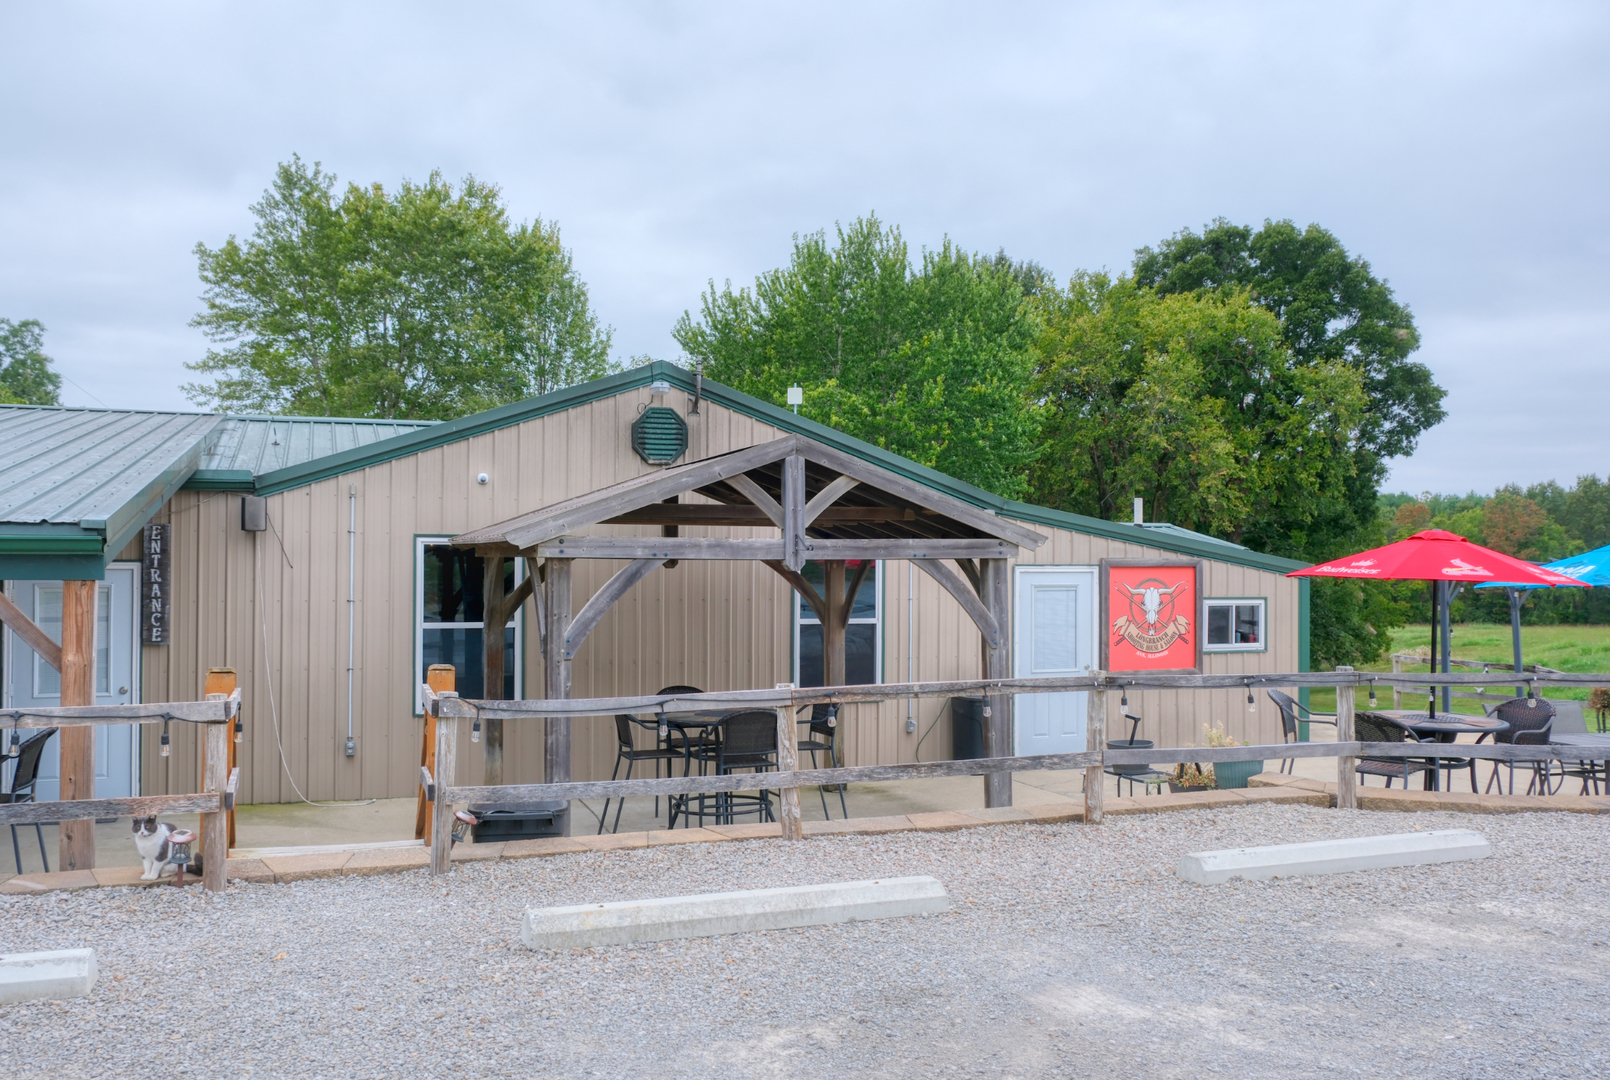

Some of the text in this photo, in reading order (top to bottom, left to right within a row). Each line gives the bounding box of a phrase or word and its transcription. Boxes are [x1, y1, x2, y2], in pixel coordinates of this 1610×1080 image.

[1314, 566, 1381, 574] Budweiser
[150, 525, 162, 642] ENTRANCE
[1126, 631, 1145, 650] SHOOTING
[1164, 631, 1178, 645] SALOON
[1135, 631, 1169, 644] LONGBRANCH
[1147, 650, 1169, 658] ILLINOIS
